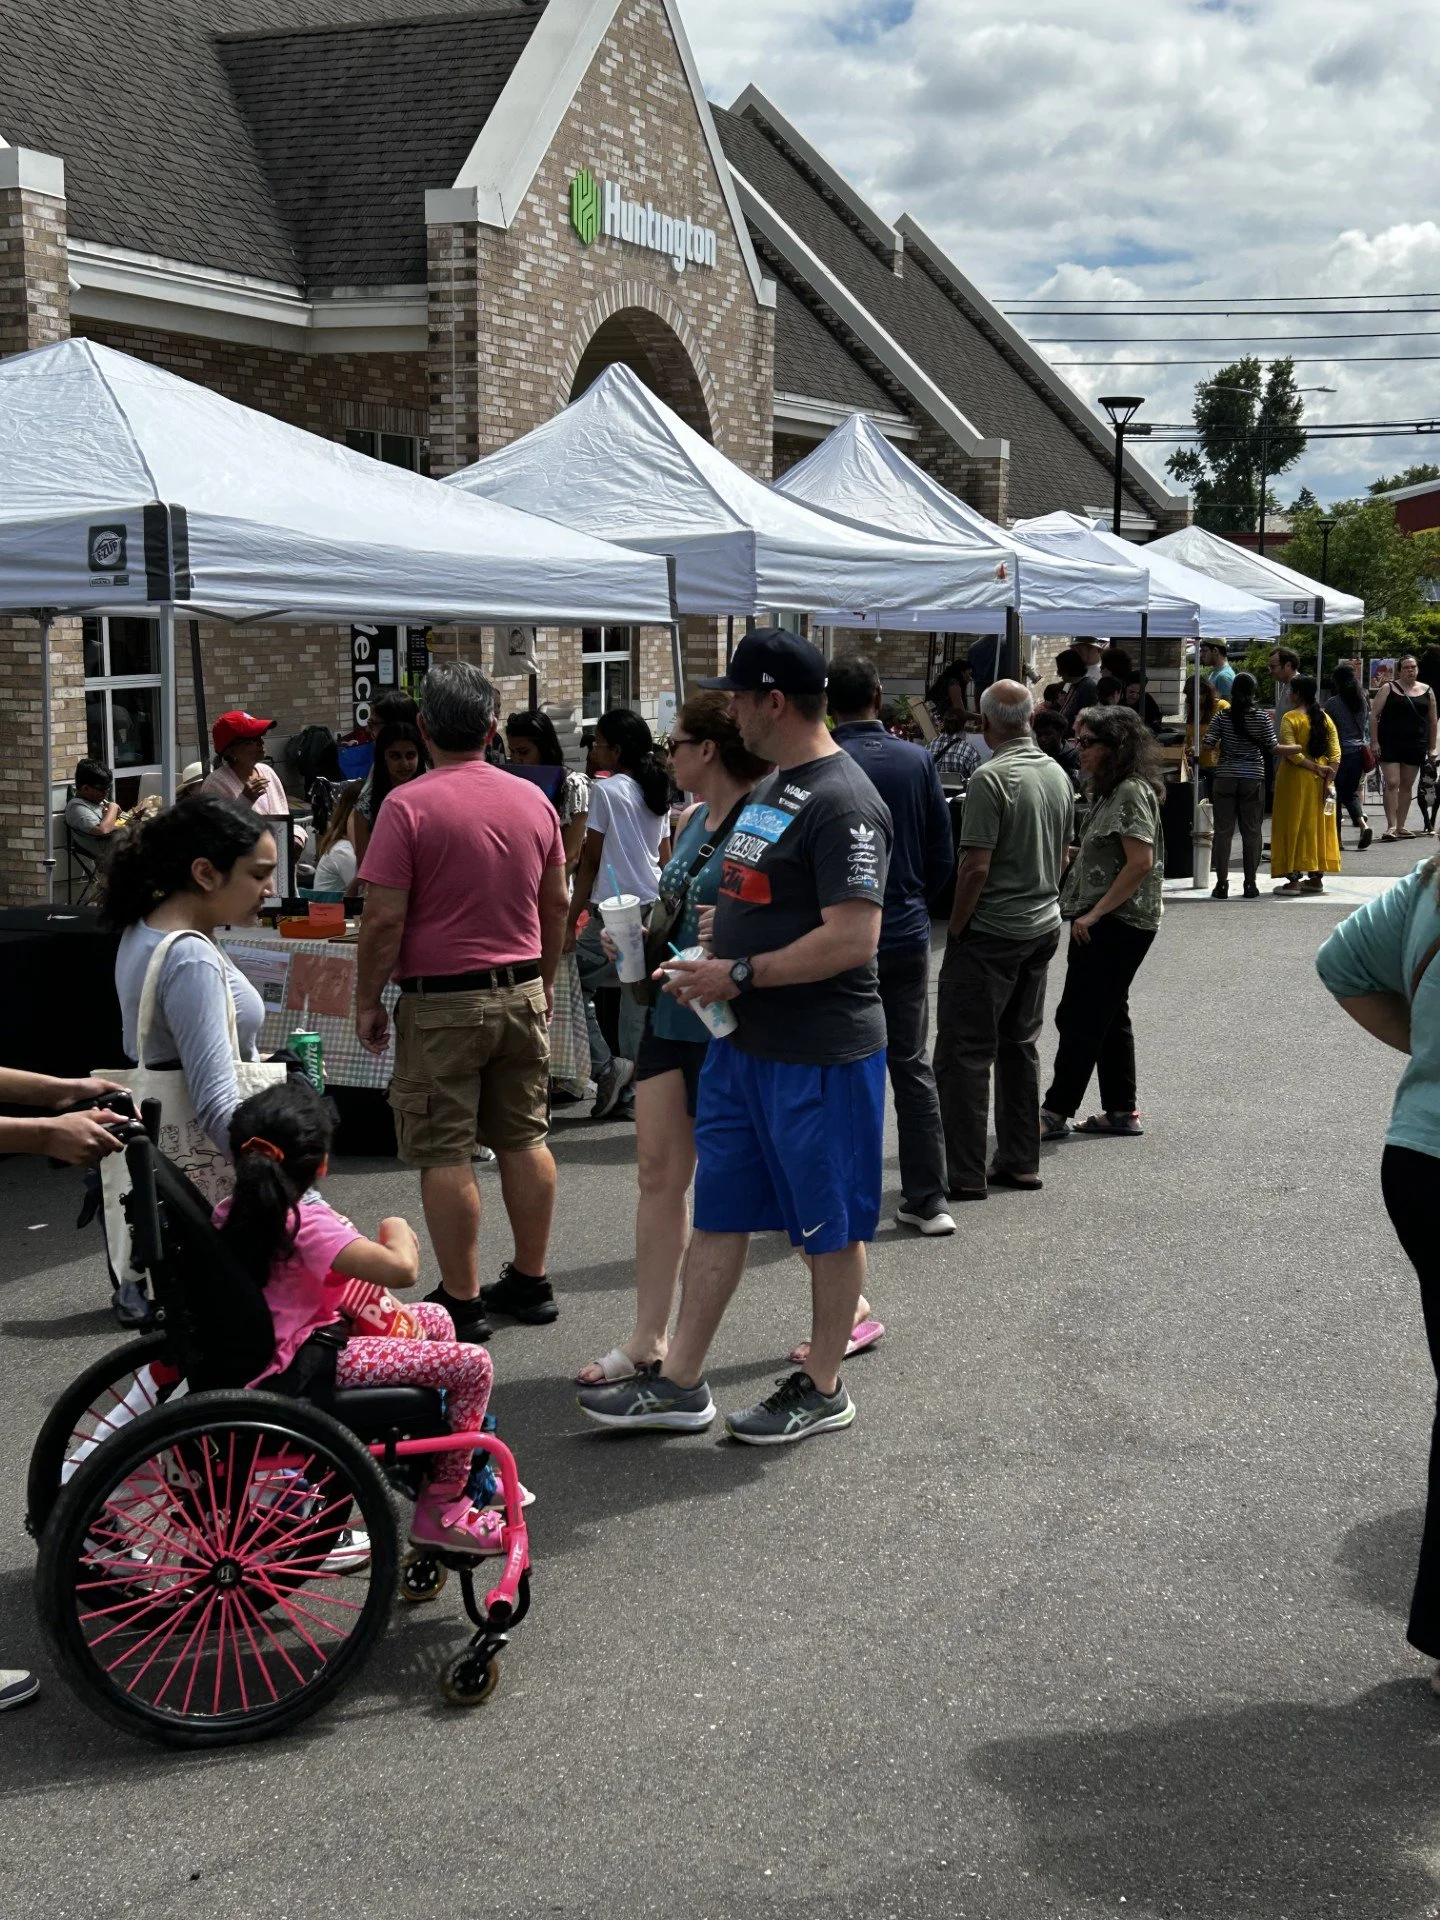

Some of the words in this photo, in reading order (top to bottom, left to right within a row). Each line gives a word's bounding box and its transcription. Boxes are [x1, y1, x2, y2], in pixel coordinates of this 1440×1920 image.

[602, 179, 717, 273] Huntington
[850, 842, 875, 851] adidas
[303, 1042, 320, 1087] Sprite
